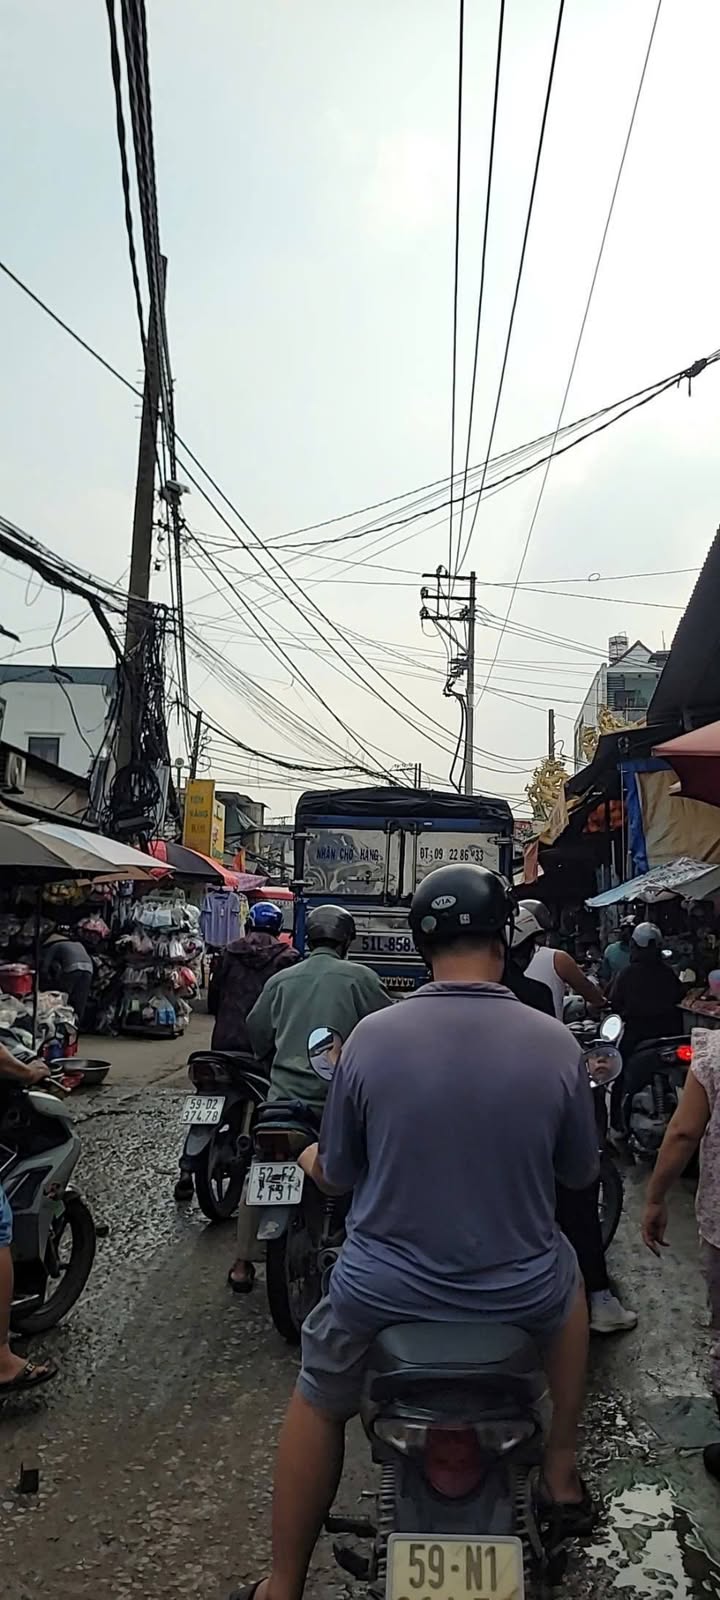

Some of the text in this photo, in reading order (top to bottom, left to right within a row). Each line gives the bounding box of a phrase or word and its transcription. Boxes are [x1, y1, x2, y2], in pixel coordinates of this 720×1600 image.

[434, 898, 452, 906] VIA
[183, 1110, 219, 1122] 374.78
[408, 1543, 498, 1592] 59-N1
